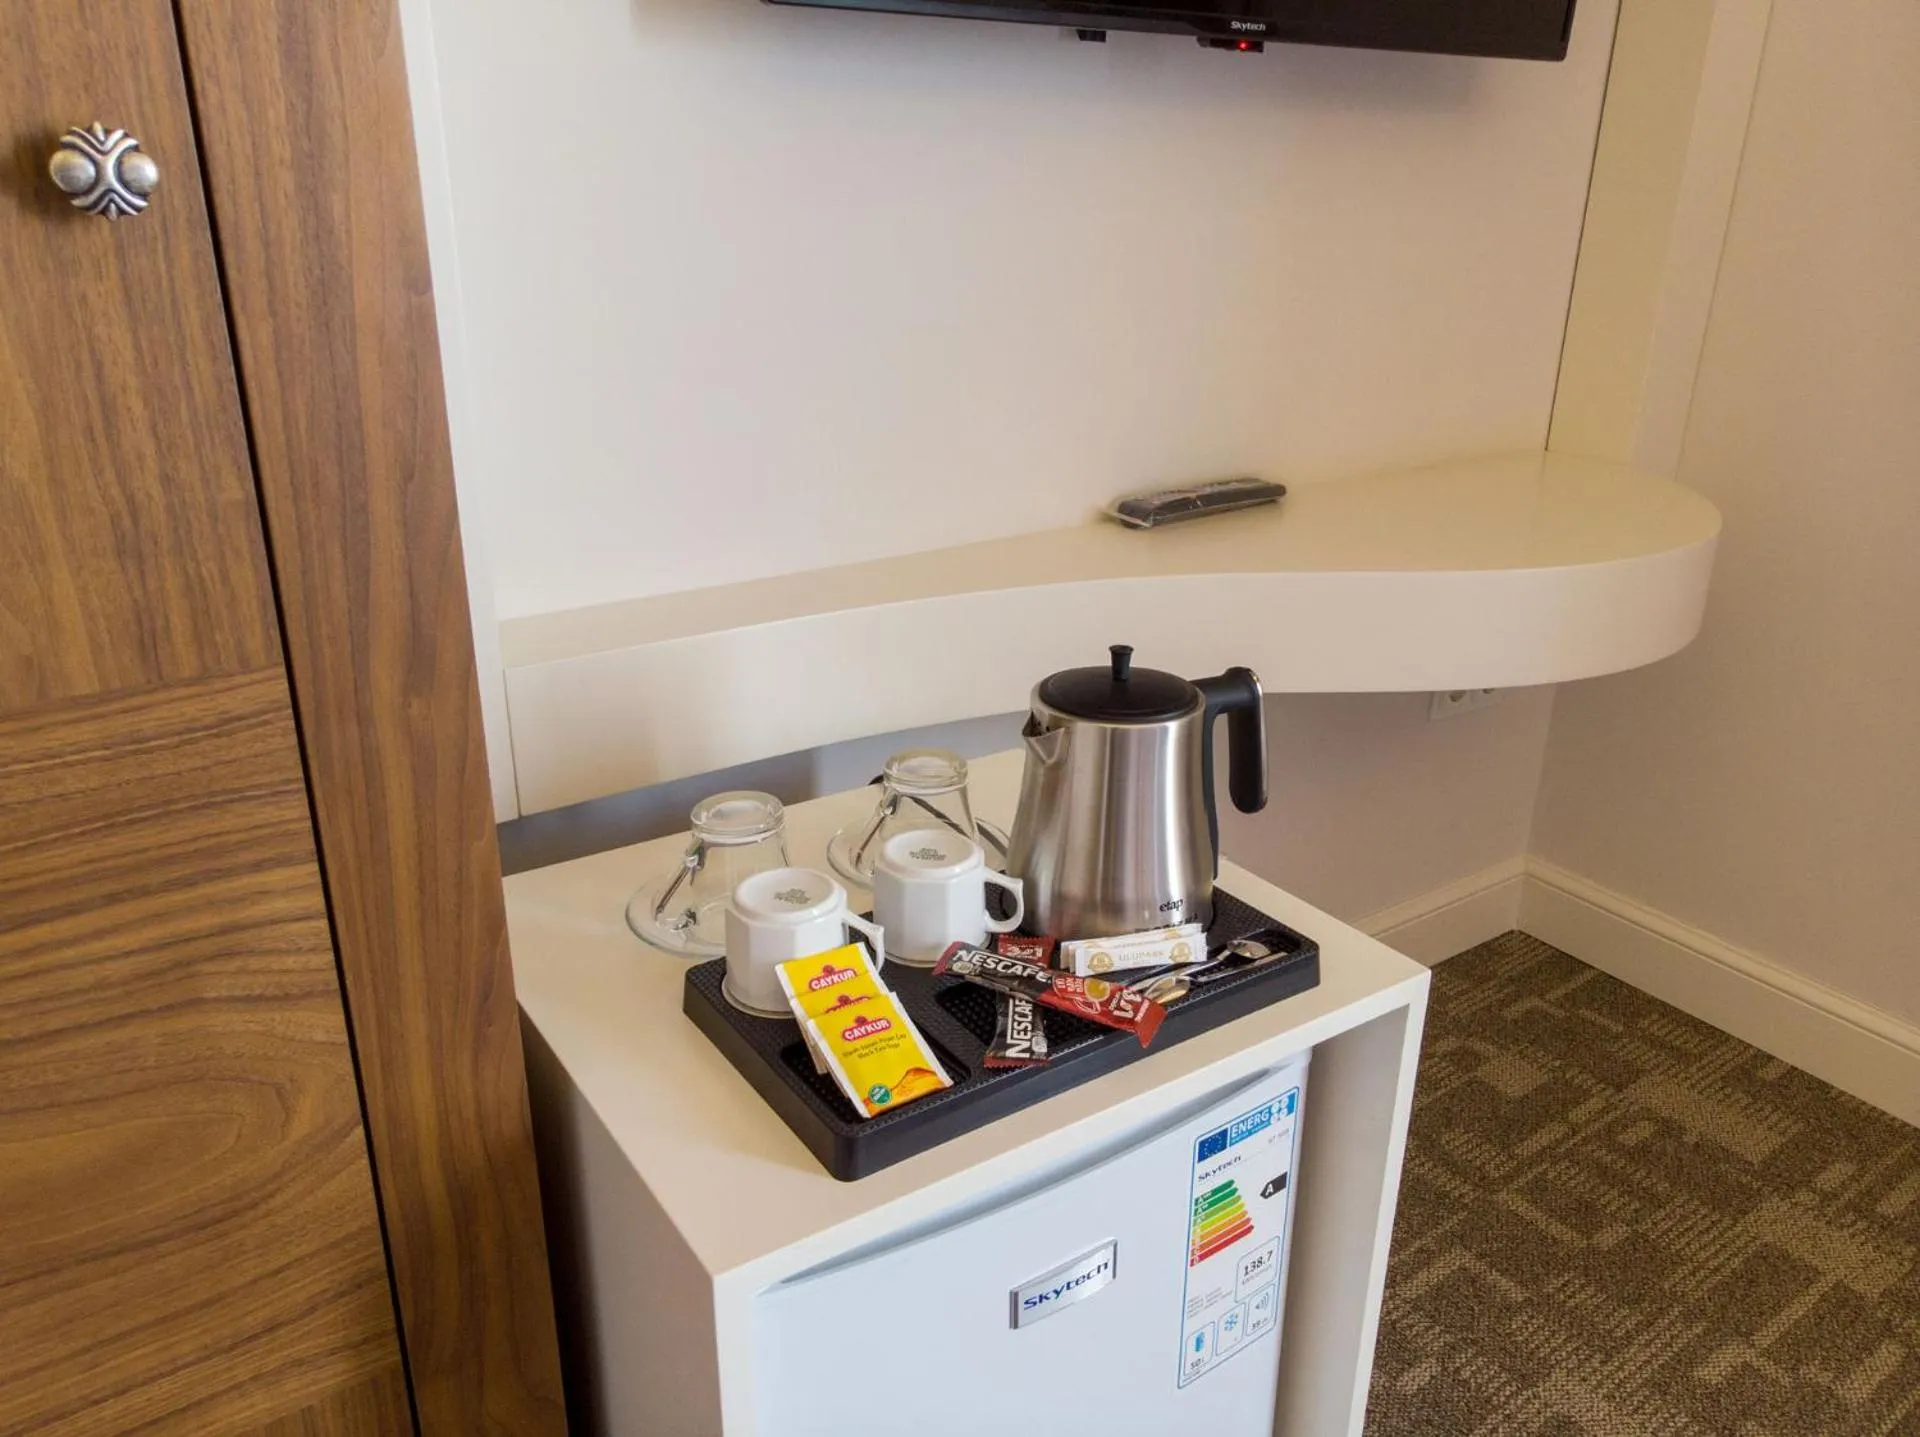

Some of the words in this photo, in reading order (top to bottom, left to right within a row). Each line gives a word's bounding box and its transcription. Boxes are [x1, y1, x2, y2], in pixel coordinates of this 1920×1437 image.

[1230, 20, 1266, 32] Skytech
[1159, 898, 1184, 912] etap
[1005, 998, 1033, 1058] NESCAF
[1231, 1108, 1270, 1138] ENERG
[1264, 1182, 1275, 1198] A
[1243, 1250, 1273, 1277] 138.7
